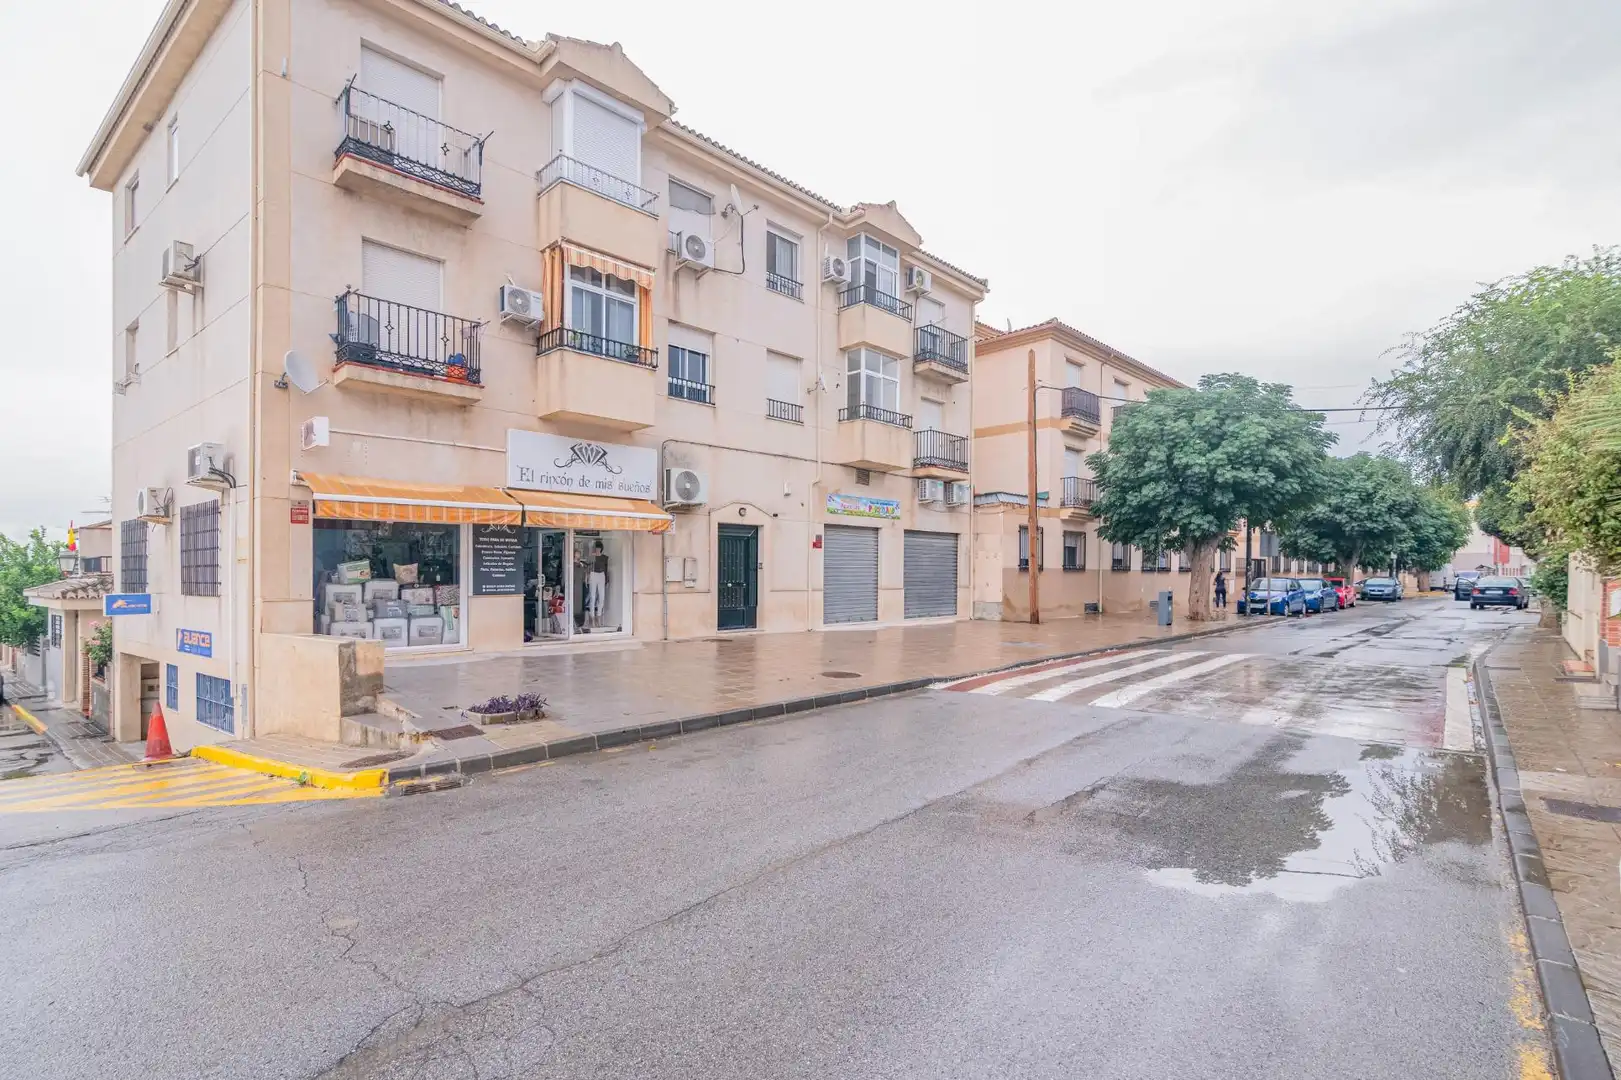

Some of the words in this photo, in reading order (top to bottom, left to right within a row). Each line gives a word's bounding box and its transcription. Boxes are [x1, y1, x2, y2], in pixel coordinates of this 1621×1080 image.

[516, 465, 534, 483] El
[540, 472, 574, 488] rincón
[579, 475, 591, 488] de
[595, 476, 615, 490] mis
[618, 478, 652, 494] sueños
